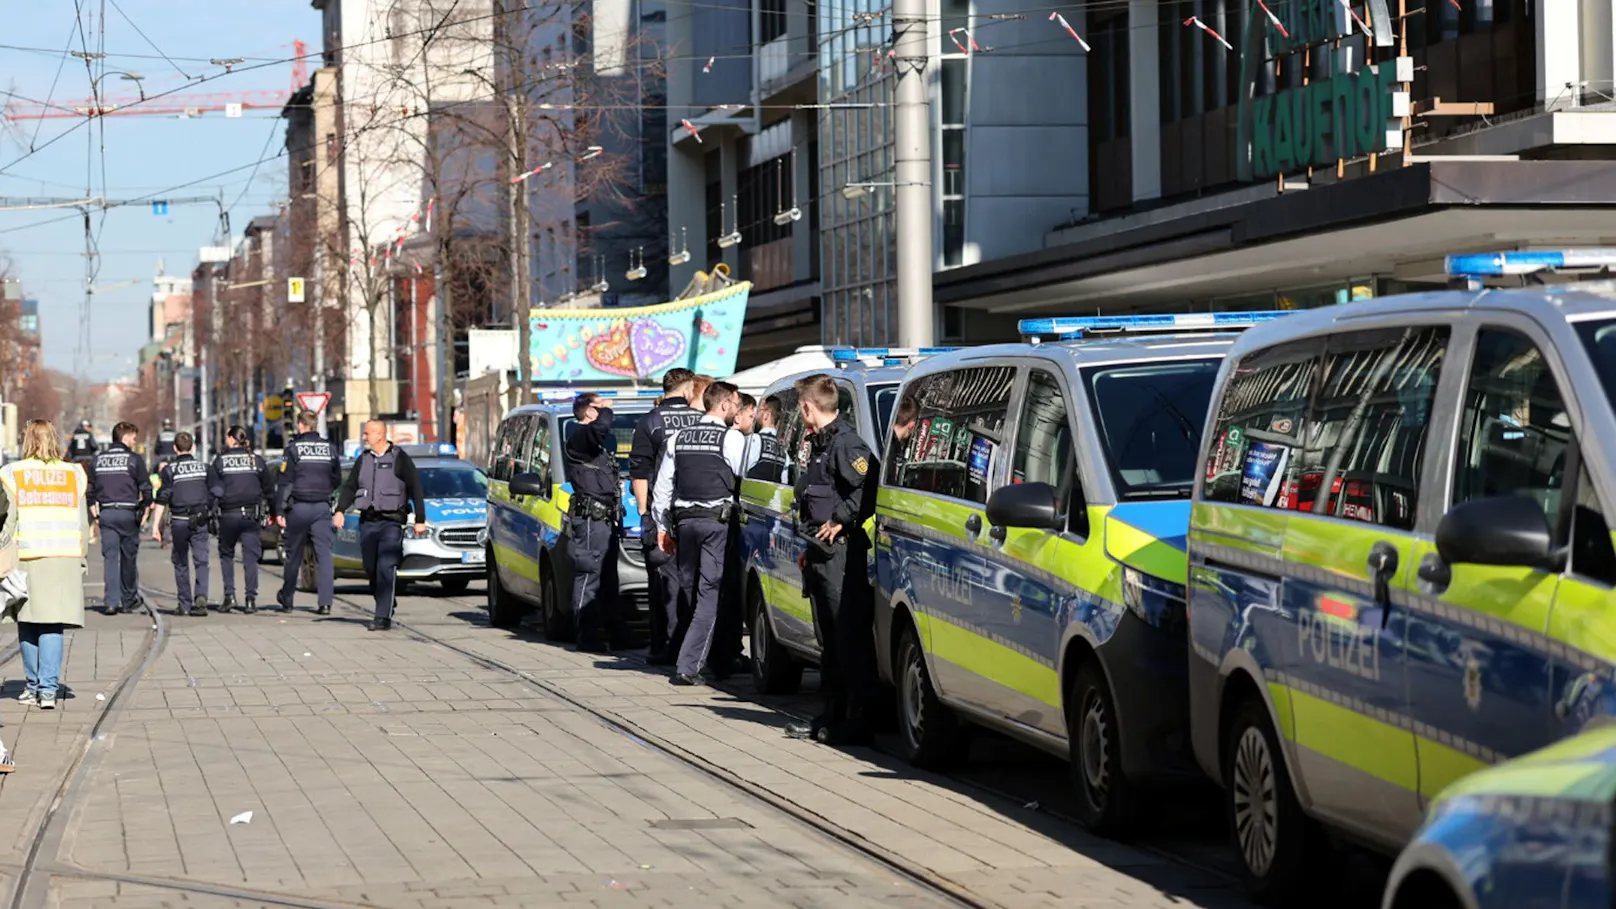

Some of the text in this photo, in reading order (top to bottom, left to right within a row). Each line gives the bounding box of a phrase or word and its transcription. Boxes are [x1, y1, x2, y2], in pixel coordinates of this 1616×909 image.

[663, 415, 701, 429] POLIZE
[677, 430, 721, 445] POLIZEI
[297, 444, 331, 456] POLIZEI
[96, 456, 128, 467] POLIZEI
[171, 462, 207, 474] POLIZEI
[222, 456, 256, 467] POLIZEI
[23, 469, 67, 487] POLIZEI
[930, 564, 973, 607] POLIZEI
[1298, 607, 1380, 681] POLIZEI
